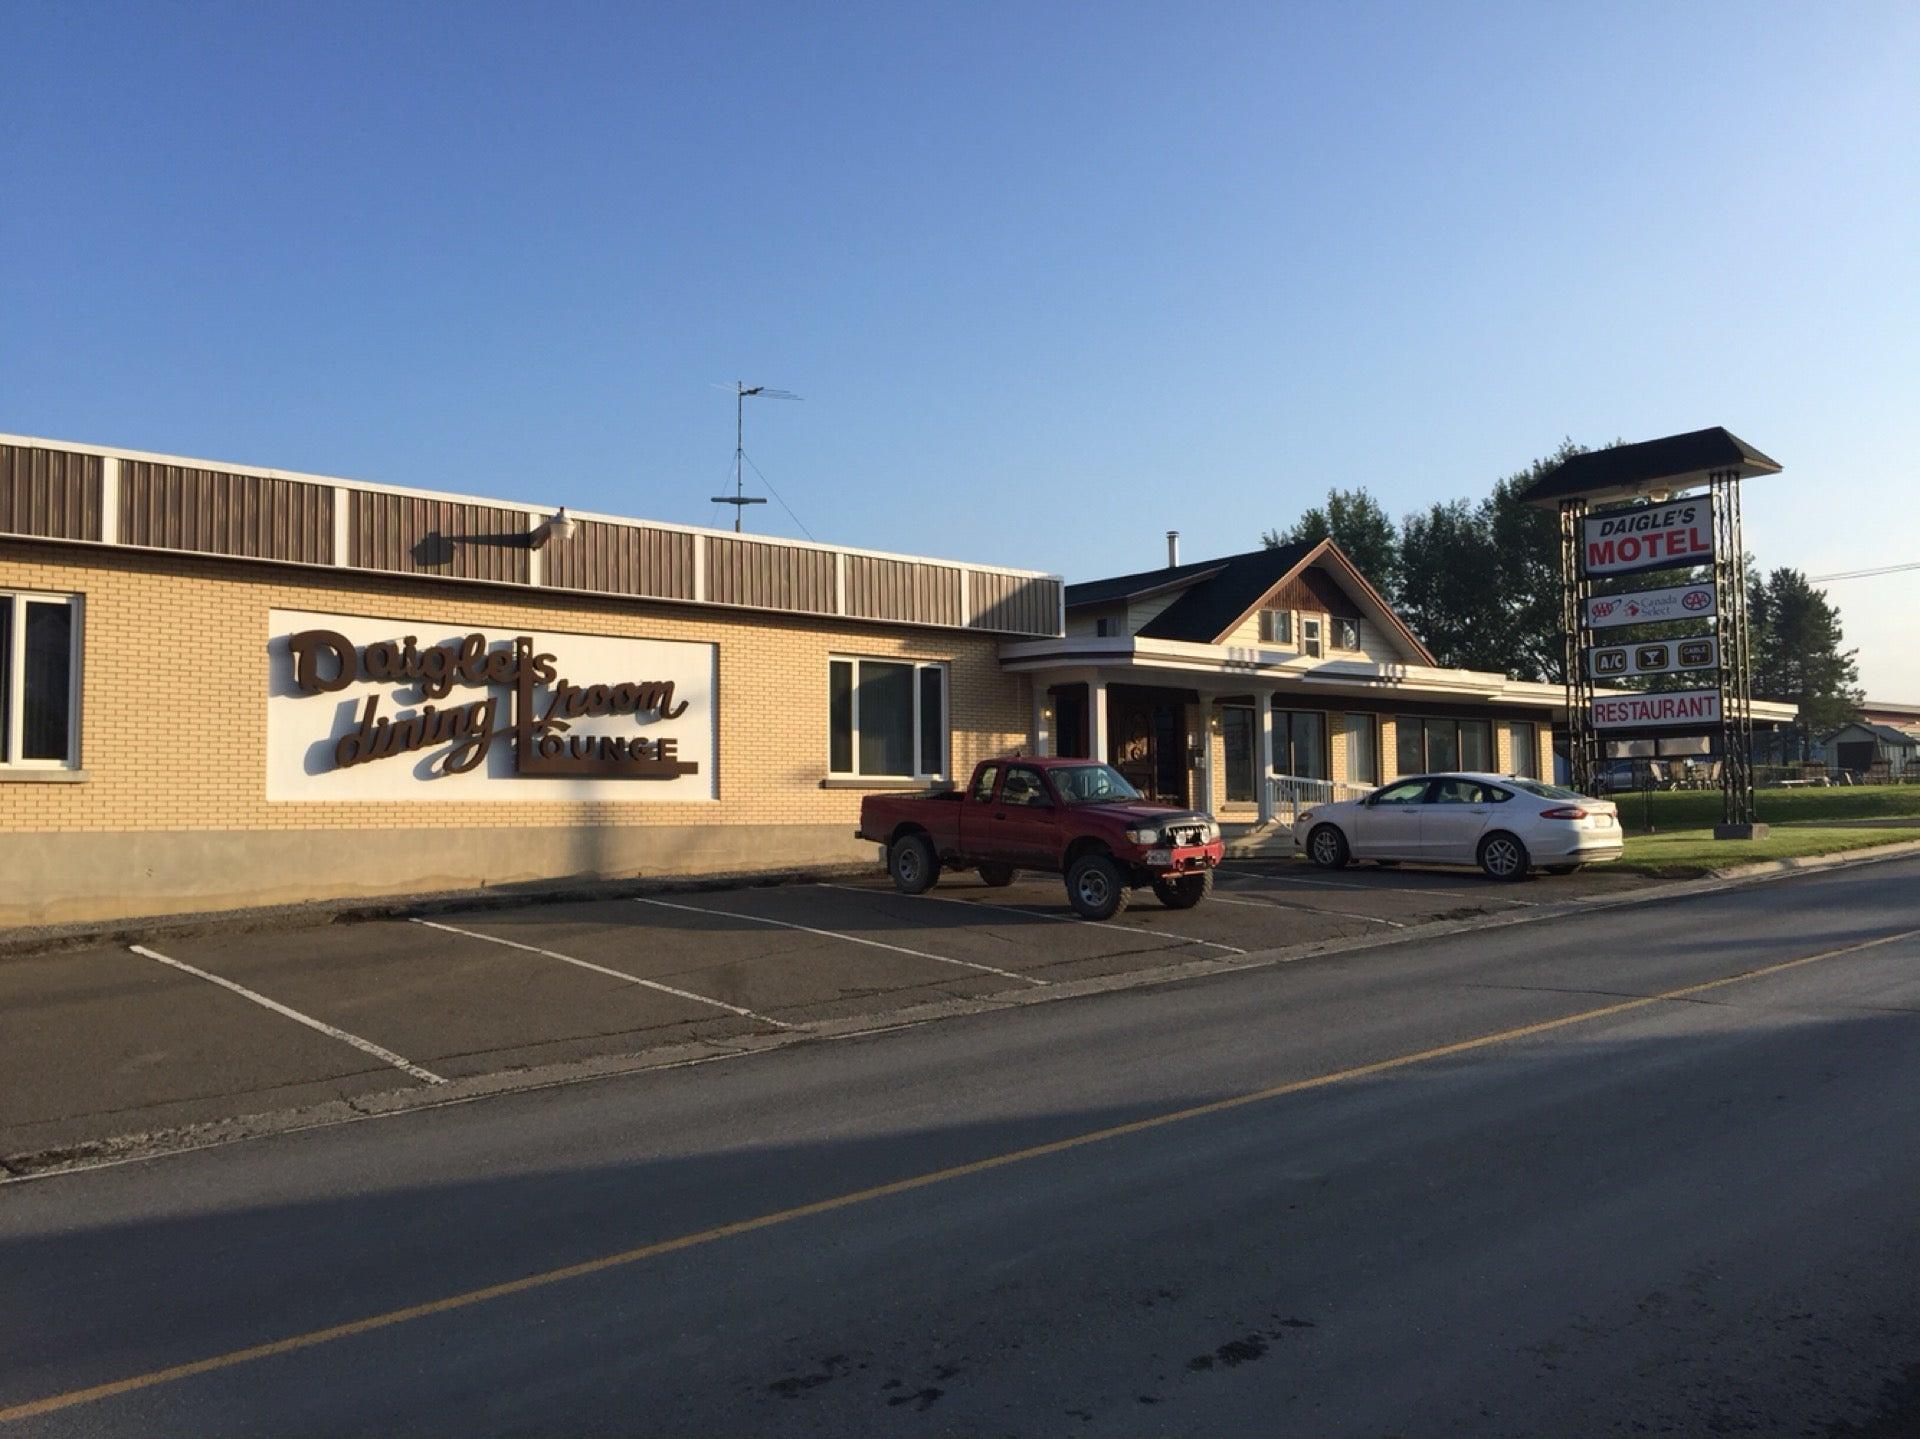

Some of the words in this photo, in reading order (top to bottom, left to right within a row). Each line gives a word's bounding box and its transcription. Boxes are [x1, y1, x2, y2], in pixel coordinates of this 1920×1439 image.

[1600, 507, 1696, 537] DAIGLE'S
[1588, 527, 1711, 566] MOTEL
[1600, 653, 1623, 669] A/C
[516, 636, 699, 780] LOUNGE
[1594, 696, 1716, 723] RESTAURANT
[334, 695, 499, 774] dining
[540, 679, 689, 727] room
